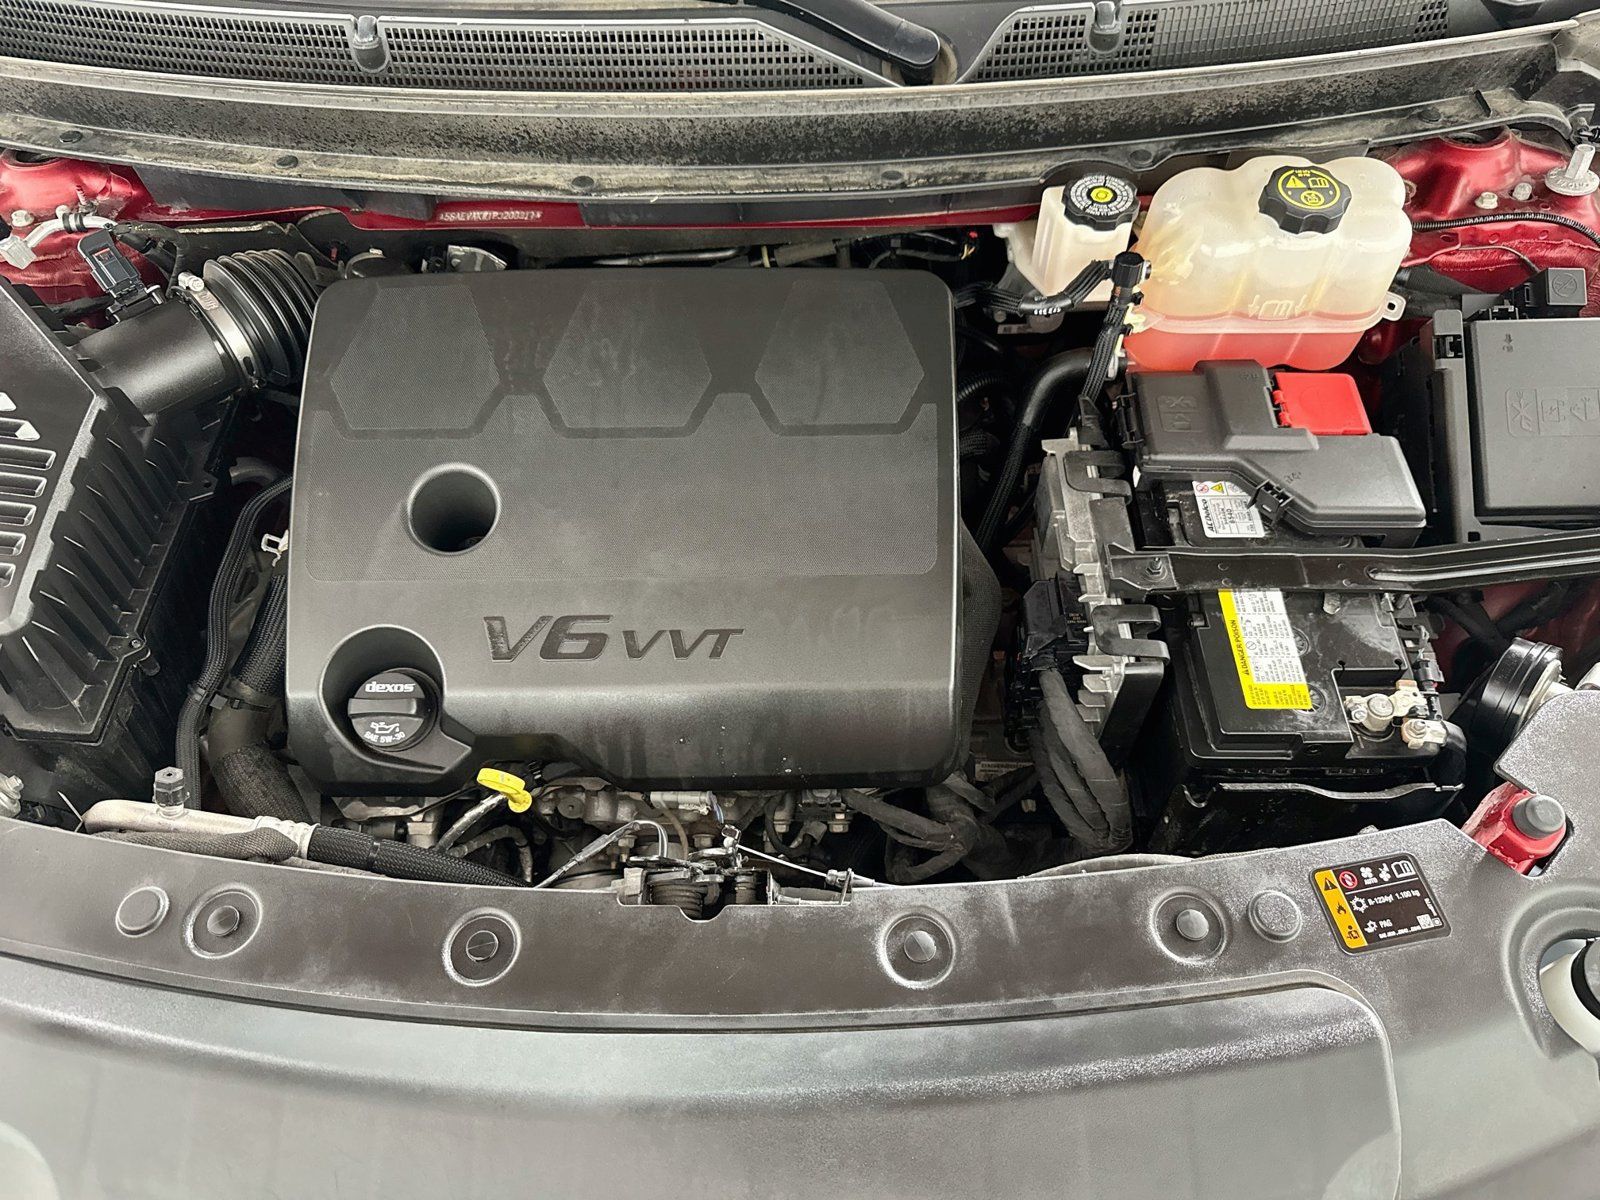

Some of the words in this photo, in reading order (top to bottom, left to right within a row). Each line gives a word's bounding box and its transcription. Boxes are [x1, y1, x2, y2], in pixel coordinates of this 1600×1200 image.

[1201, 498, 1215, 533] ACDelco
[483, 614, 613, 662] V6
[622, 628, 744, 660] VVT
[365, 681, 416, 692] dexos
[364, 731, 379, 742] SAE
[380, 731, 406, 743] 5W-30
